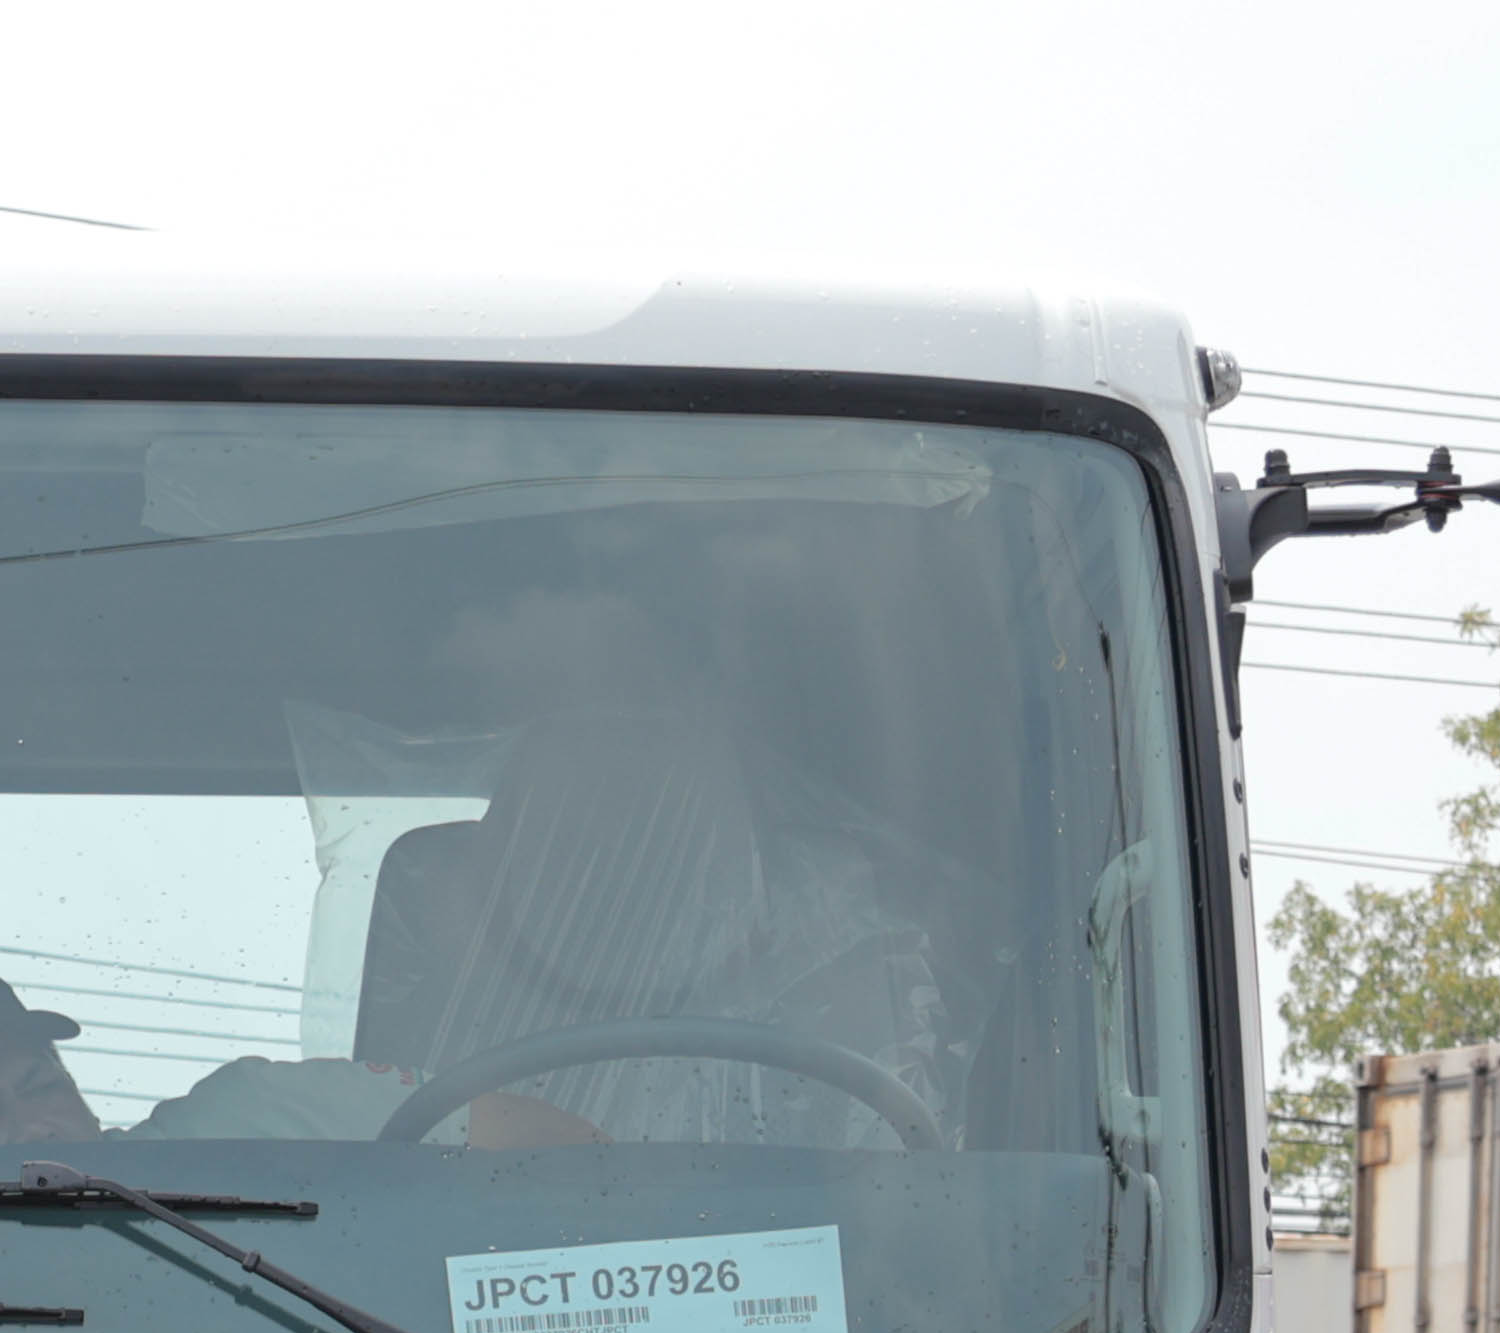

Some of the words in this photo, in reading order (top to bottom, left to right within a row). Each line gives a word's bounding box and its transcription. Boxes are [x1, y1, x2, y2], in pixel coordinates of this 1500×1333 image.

[465, 1271, 576, 1312] JPCT
[592, 1259, 741, 1301] 037926
[743, 1316, 771, 1328] JPCT
[774, 1313, 812, 1325] 037926
